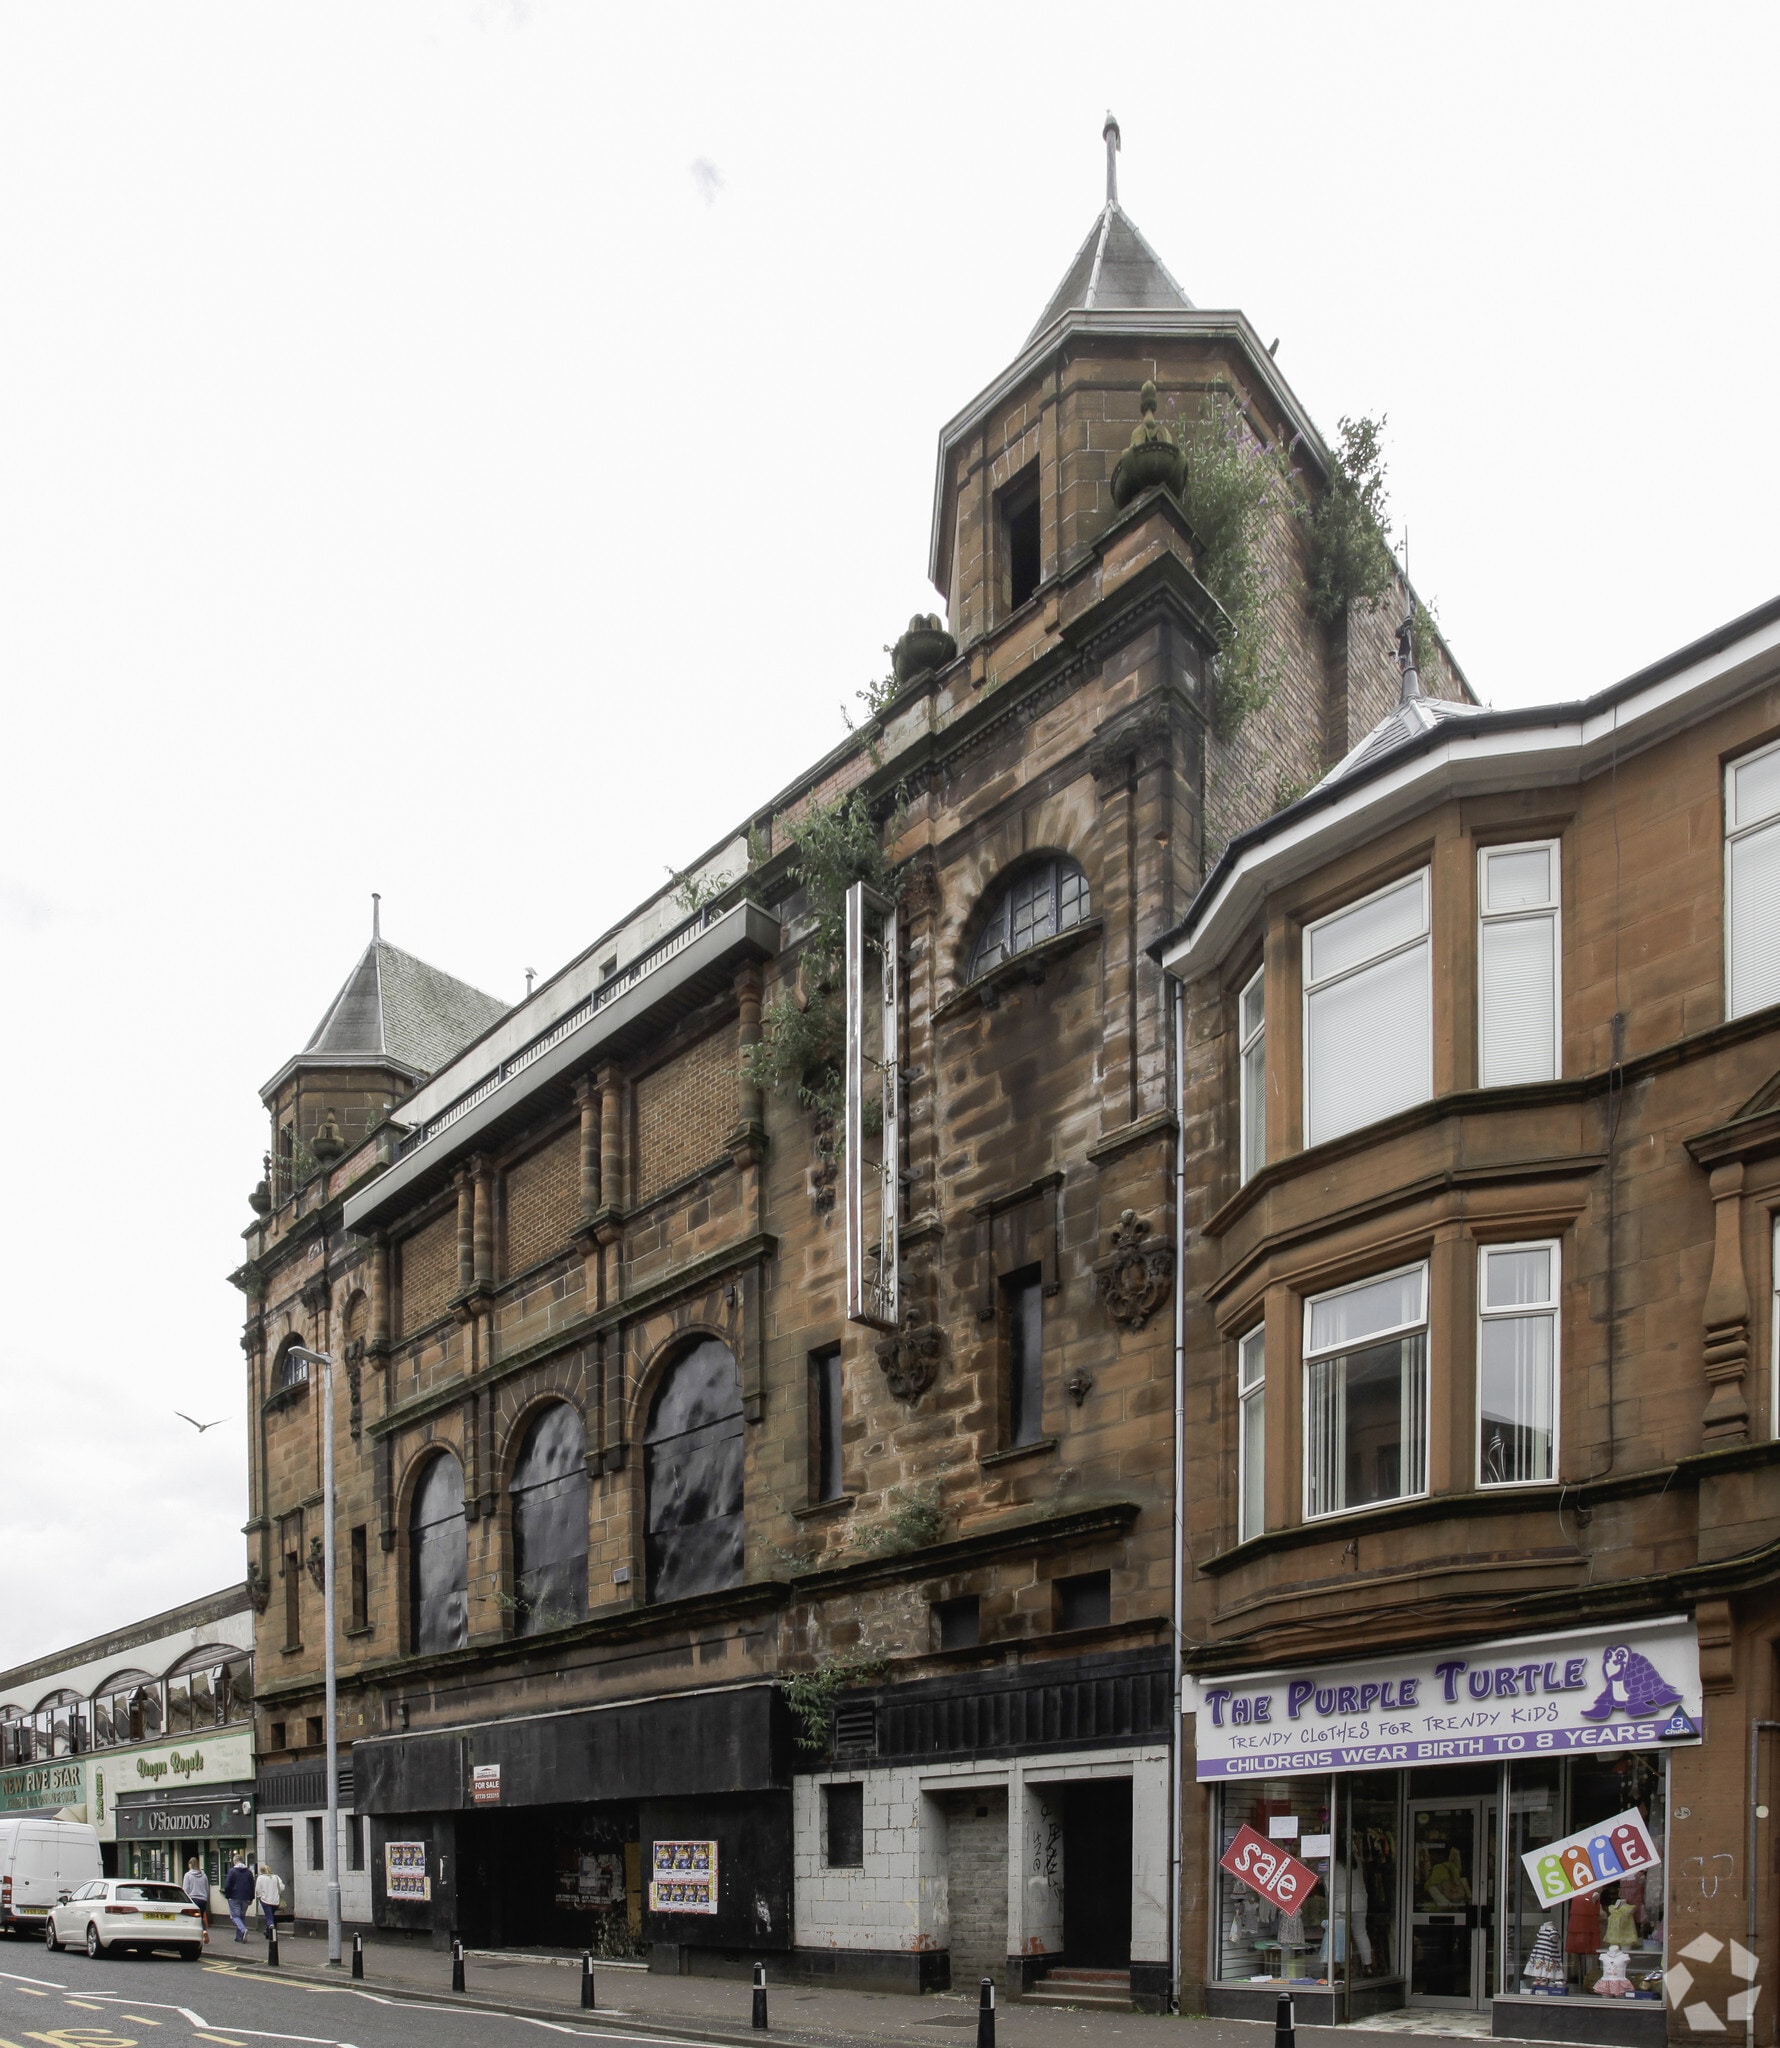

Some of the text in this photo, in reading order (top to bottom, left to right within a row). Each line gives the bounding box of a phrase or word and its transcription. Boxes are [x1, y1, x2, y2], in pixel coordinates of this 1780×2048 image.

[1205, 1658, 1588, 1727] THE PURPLE TURTLE
[1226, 1723, 1656, 1774] CHILDRENS WEAR BIRTH TO 8 YEARS
[1228, 1731, 1293, 1750] TRENDY
[1300, 1721, 1370, 1744] CLOTHES
[1378, 1721, 1413, 1736] FOR
[1423, 1711, 1501, 1732] TRENDY
[2, 1766, 81, 1796] NEW FIVE STAR
[136, 1756, 168, 1782] Dragon
[170, 1749, 205, 1779] Royale
[475, 1780, 500, 1790] FOR SALE
[1545, 1839, 1645, 1895] SALE
